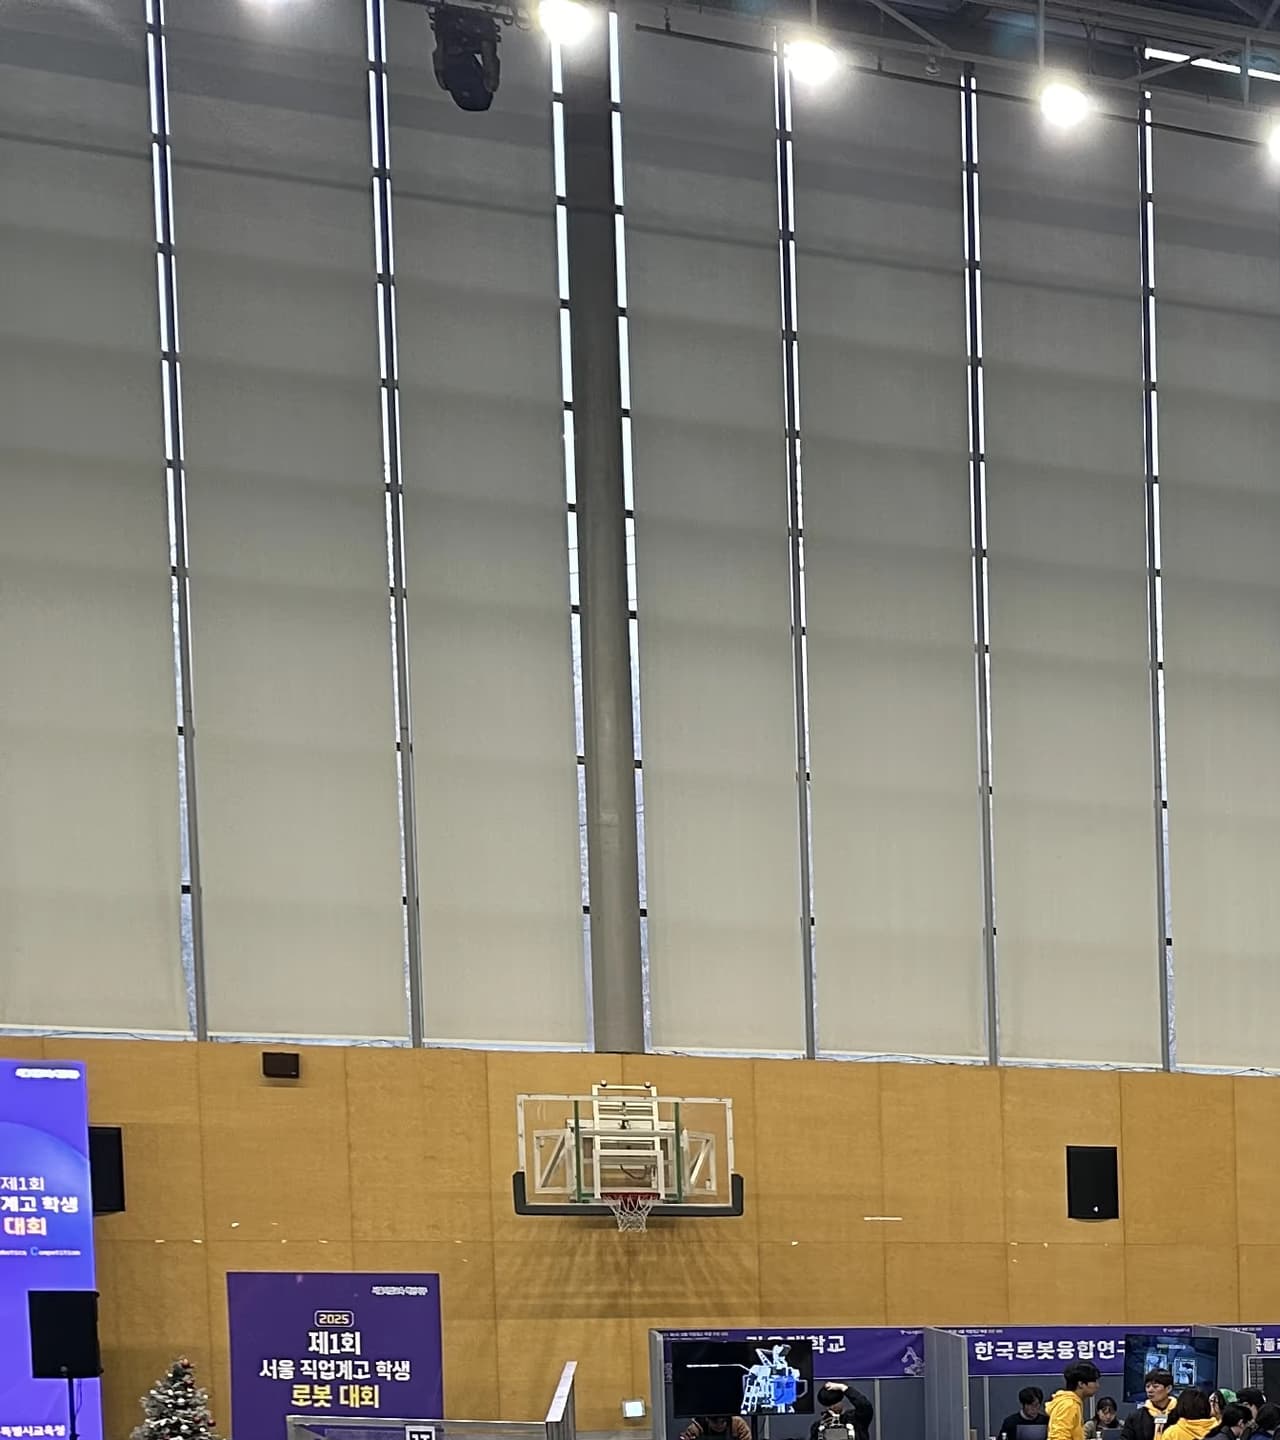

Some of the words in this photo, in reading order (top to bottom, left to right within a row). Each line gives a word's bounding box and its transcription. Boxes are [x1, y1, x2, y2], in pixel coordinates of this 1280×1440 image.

[0, 1176, 45, 1191] 제1회
[42, 1196, 79, 1213] 학생
[4, 1216, 47, 1235] 대회
[319, 1313, 350, 1325] 2025
[308, 1331, 361, 1355] 제1회
[259, 1360, 296, 1380] 서울
[300, 1360, 371, 1380] 직업계고
[376, 1360, 411, 1381] 학생
[291, 1384, 333, 1407] 로봇
[339, 1384, 380, 1409] 대회
